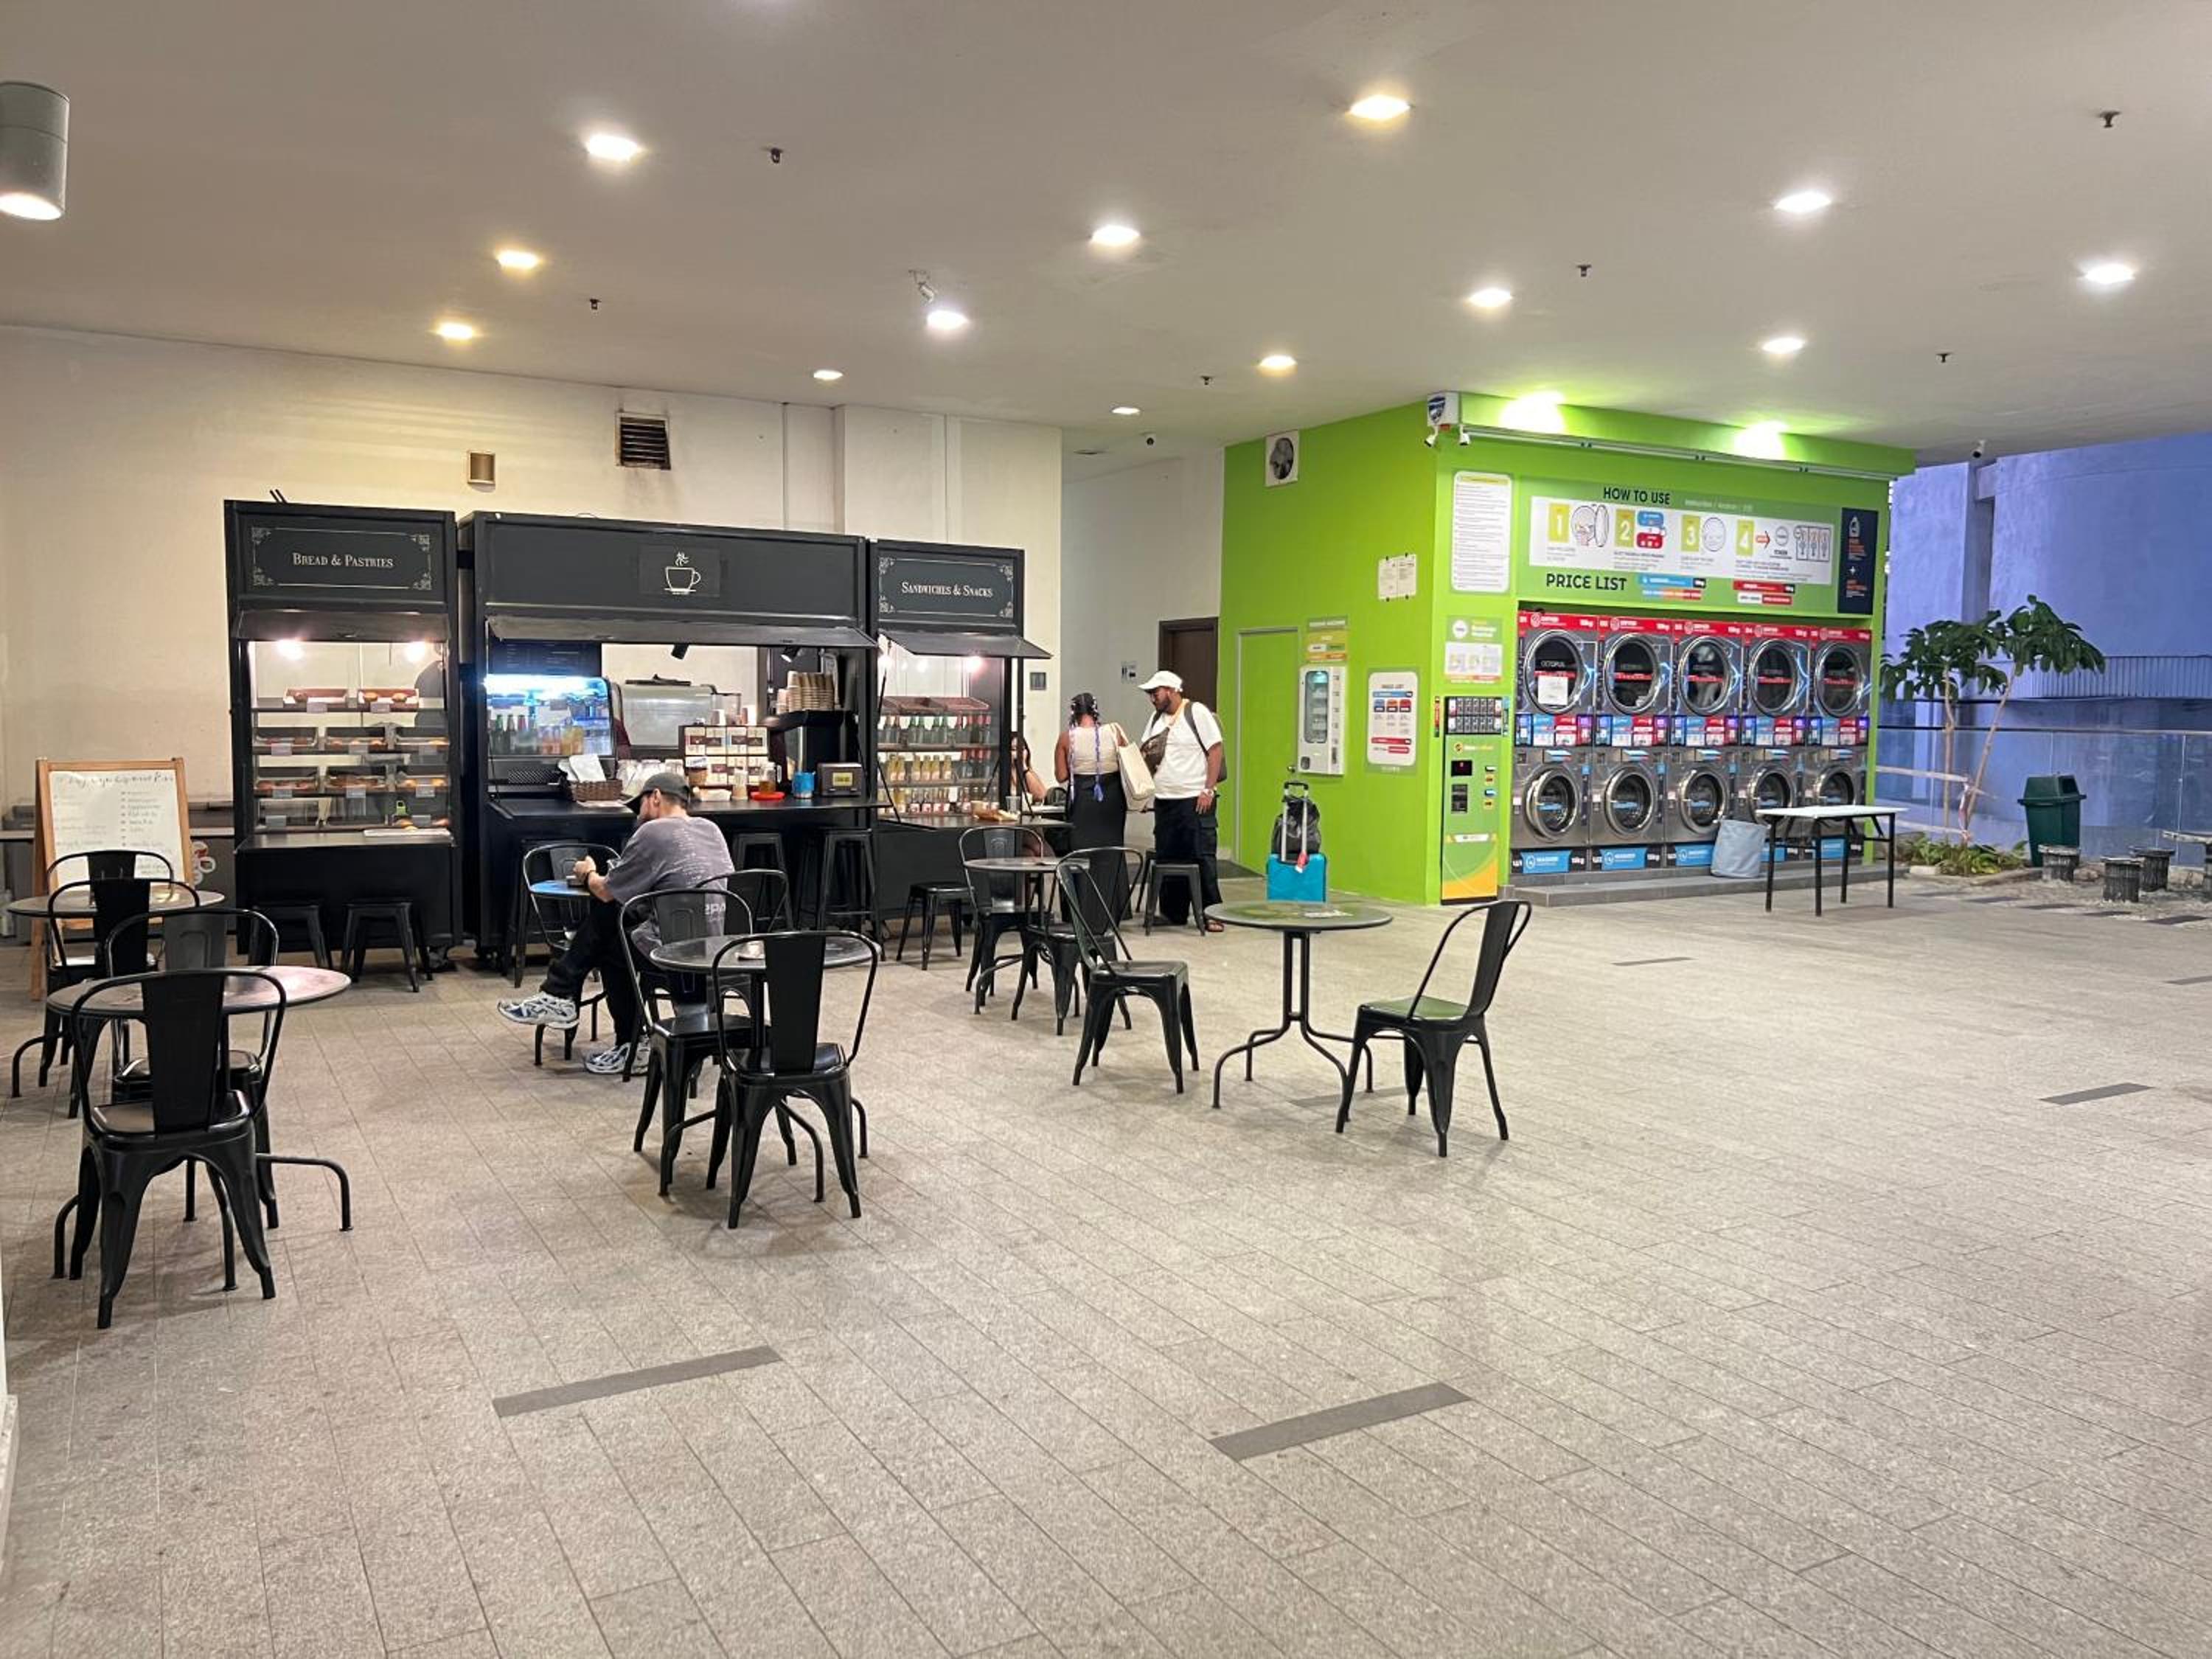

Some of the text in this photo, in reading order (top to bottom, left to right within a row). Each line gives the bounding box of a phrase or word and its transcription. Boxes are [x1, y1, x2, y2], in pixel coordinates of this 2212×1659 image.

[1603, 487, 1670, 505] HOW TO USE
[1620, 521, 1631, 541] 2
[1686, 525, 1696, 546] 3
[1739, 529, 1752, 549] 4
[331, 554, 341, 566] &
[953, 584, 961, 596] &
[1546, 574, 1591, 589] PRICE
[1596, 576, 1627, 591] LIST
